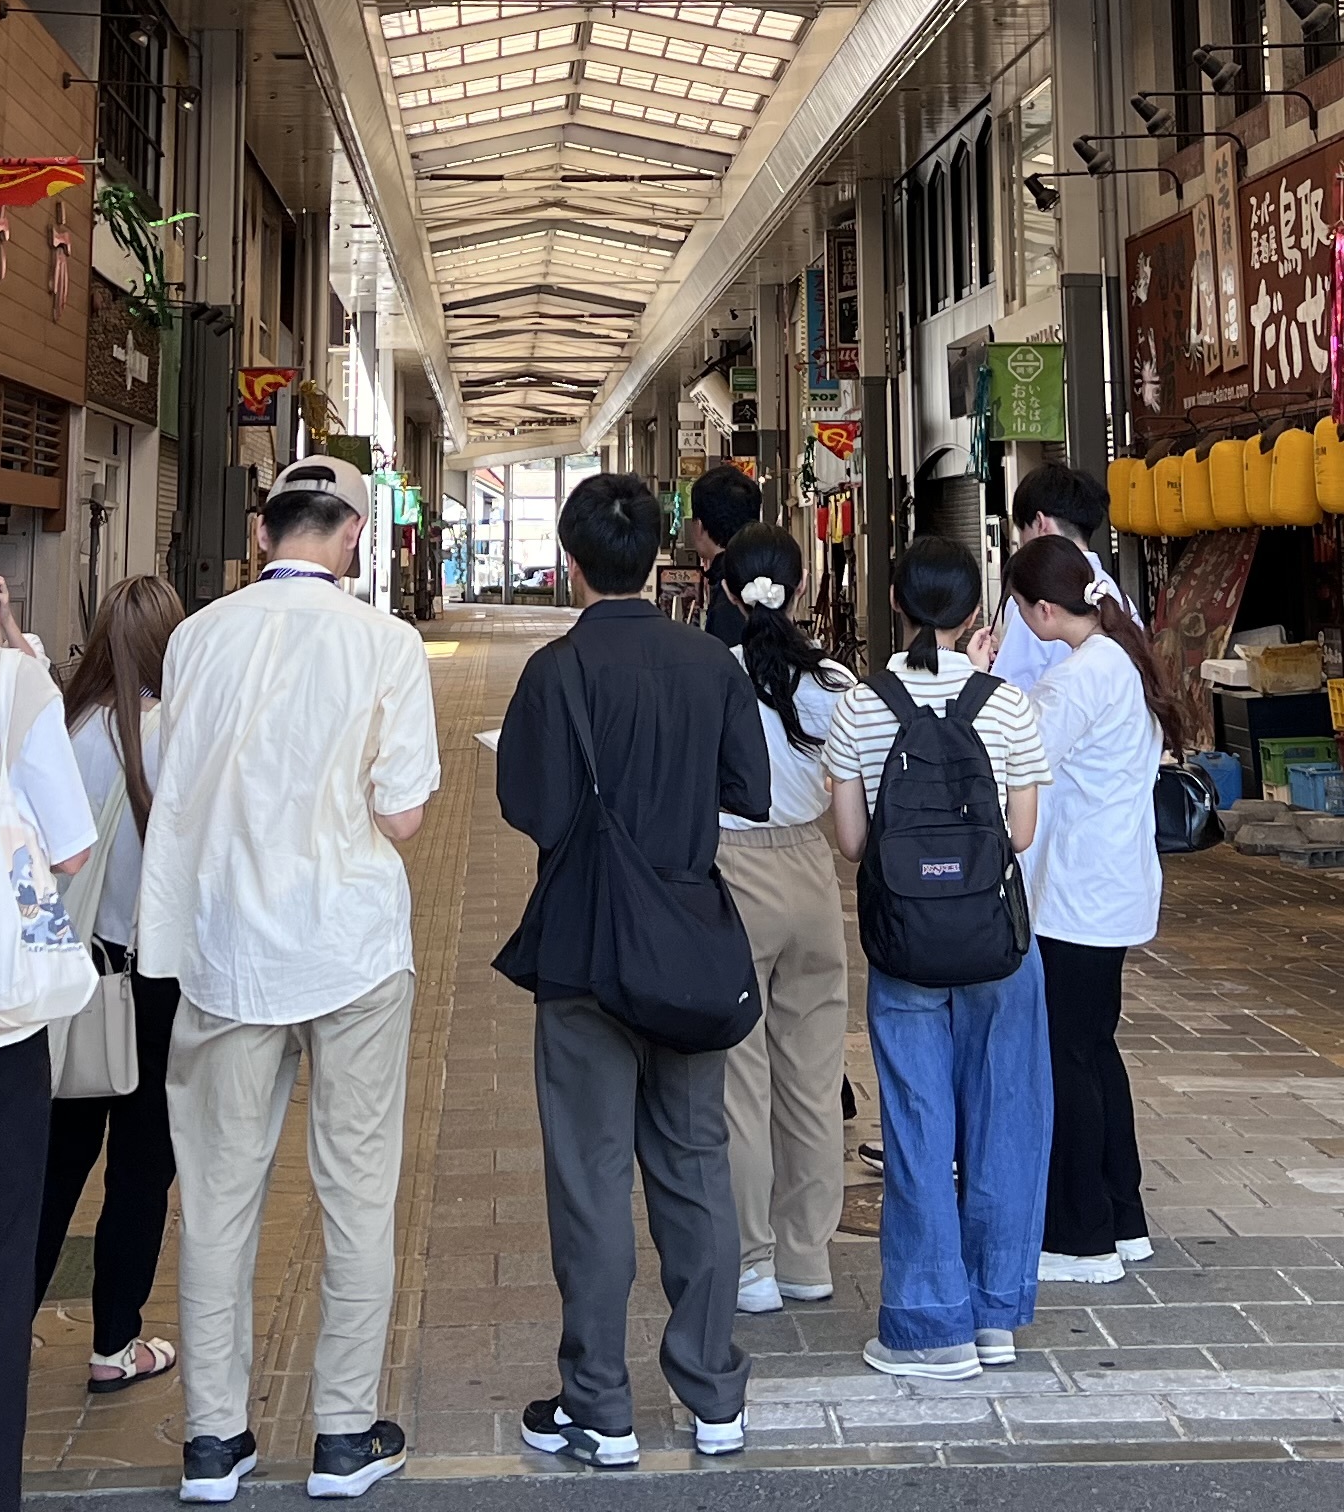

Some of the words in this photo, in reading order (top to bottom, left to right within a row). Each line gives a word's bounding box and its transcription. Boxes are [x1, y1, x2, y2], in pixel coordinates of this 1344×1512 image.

[1278, 177, 1333, 278] 鳥取
[810, 393, 838, 402] TOP
[1029, 384, 1042, 433] いなばの
